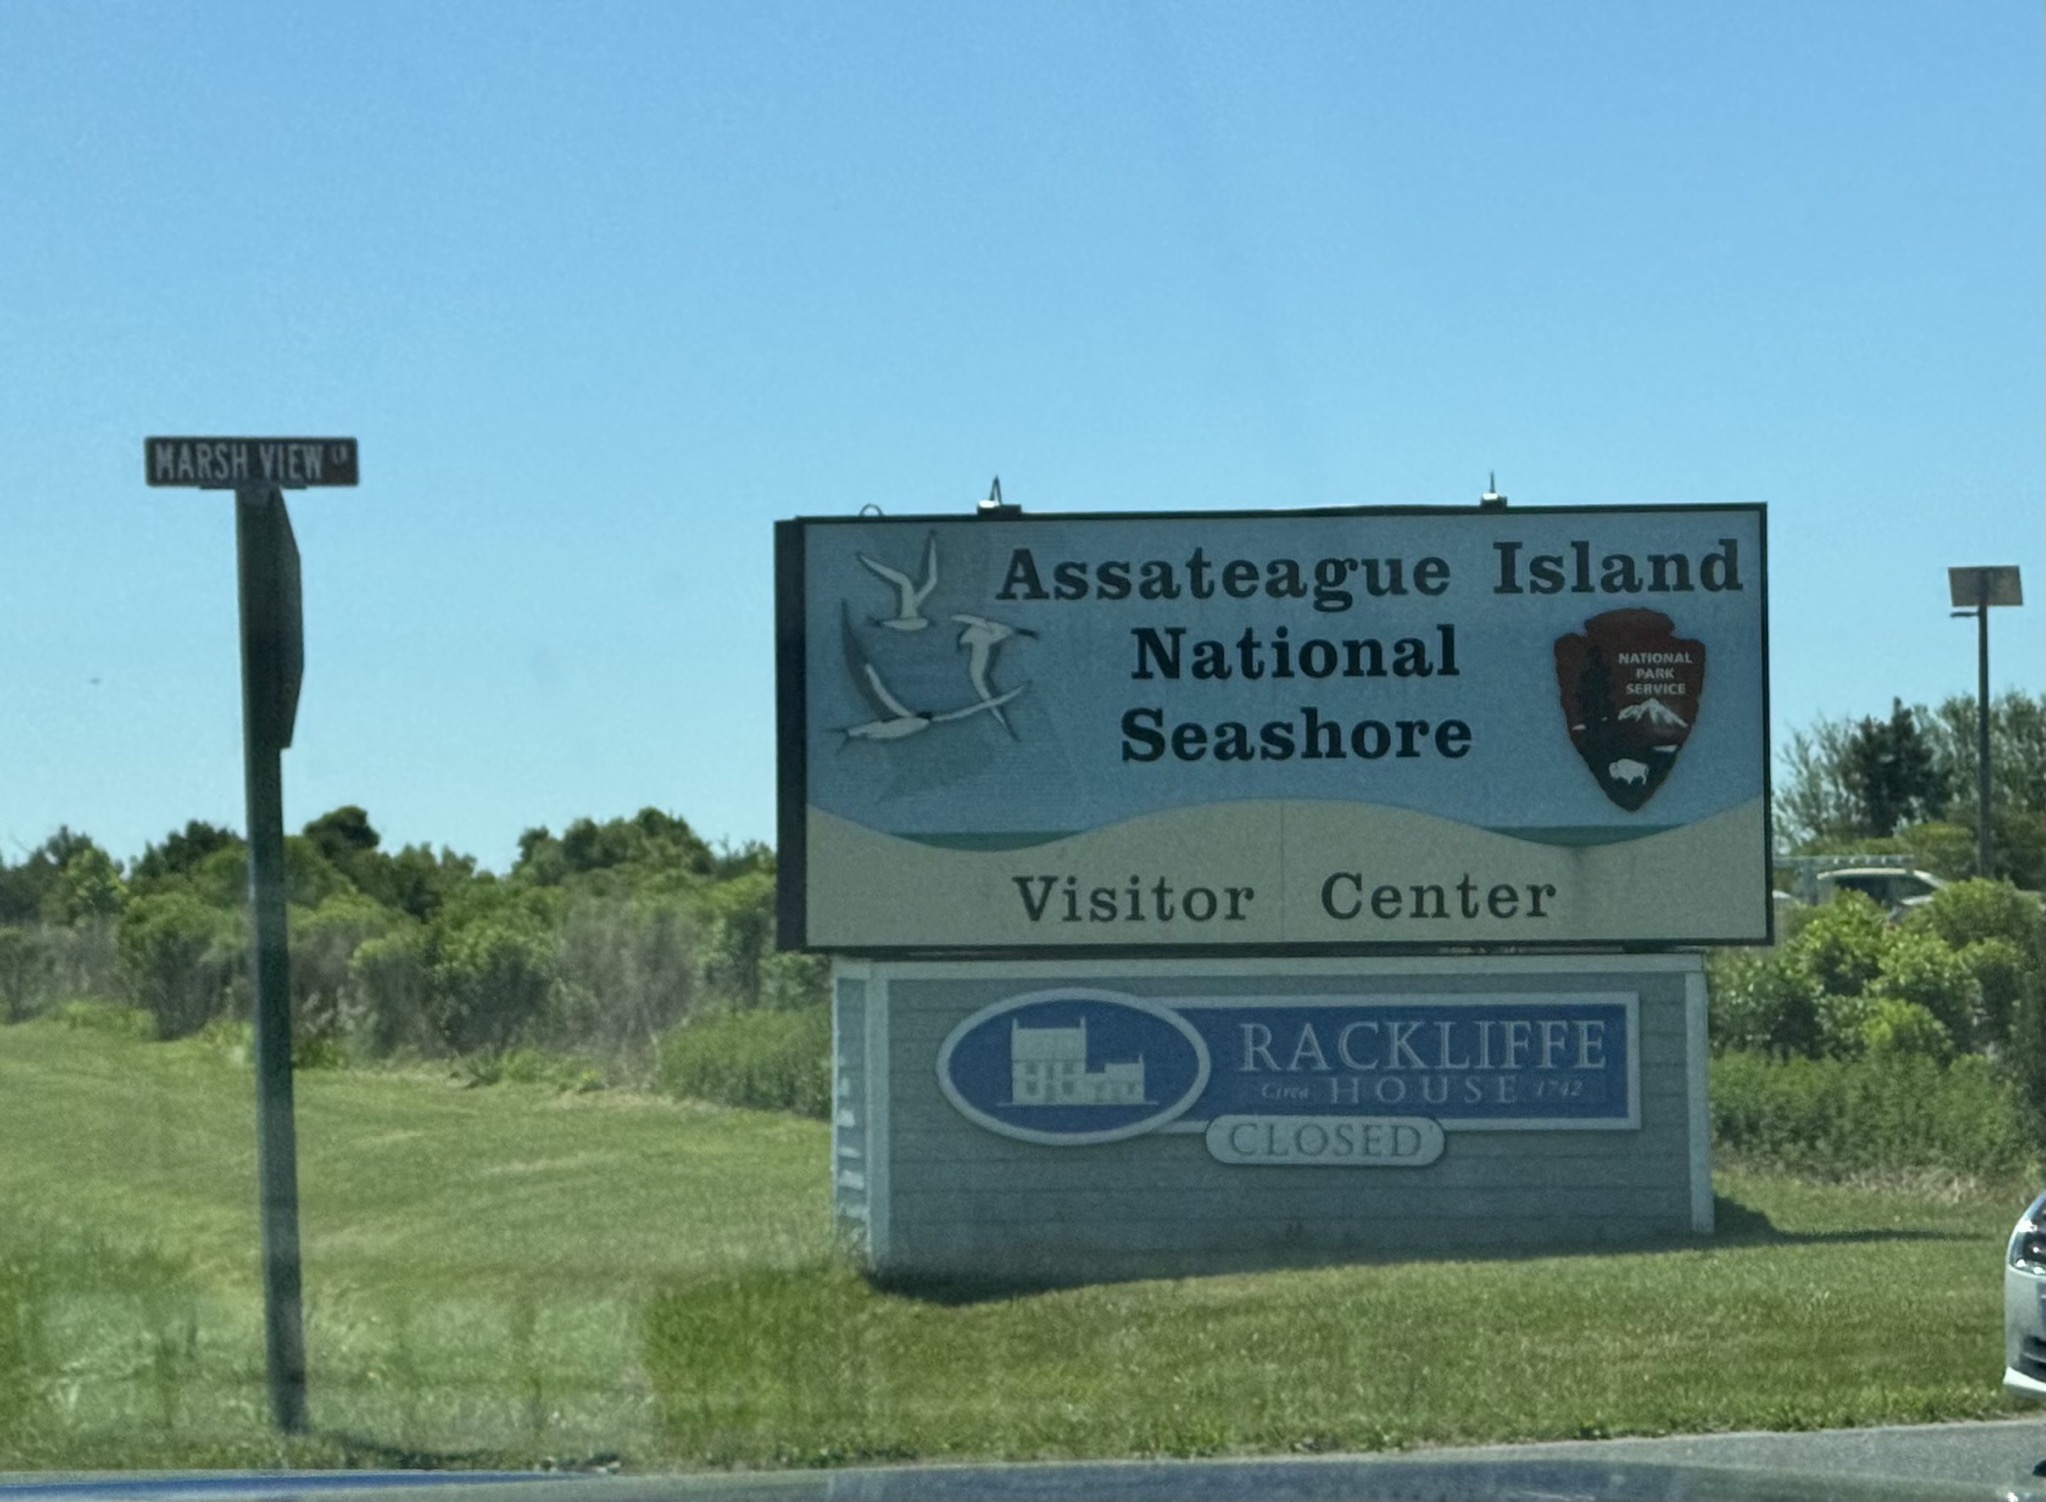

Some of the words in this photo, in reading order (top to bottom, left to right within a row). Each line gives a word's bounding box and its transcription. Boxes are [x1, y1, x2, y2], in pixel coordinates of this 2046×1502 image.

[155, 443, 249, 480] MARSH
[258, 443, 323, 480] VIEW
[996, 546, 1452, 613] Assateague
[1492, 539, 1744, 595] Island
[1131, 624, 1460, 681] National
[1618, 652, 1693, 664] NATIONAL
[1626, 683, 1686, 695] SERVICE
[1636, 667, 1675, 679] PARK
[1121, 706, 1473, 763] Seashore
[1012, 874, 1255, 923] Visitor
[1321, 871, 1557, 920] Center
[1239, 1020, 1607, 1072] RACKLIFFE
[1329, 1074, 1519, 1105] HOUSE
[1228, 1123, 1422, 1159] CLOSED
